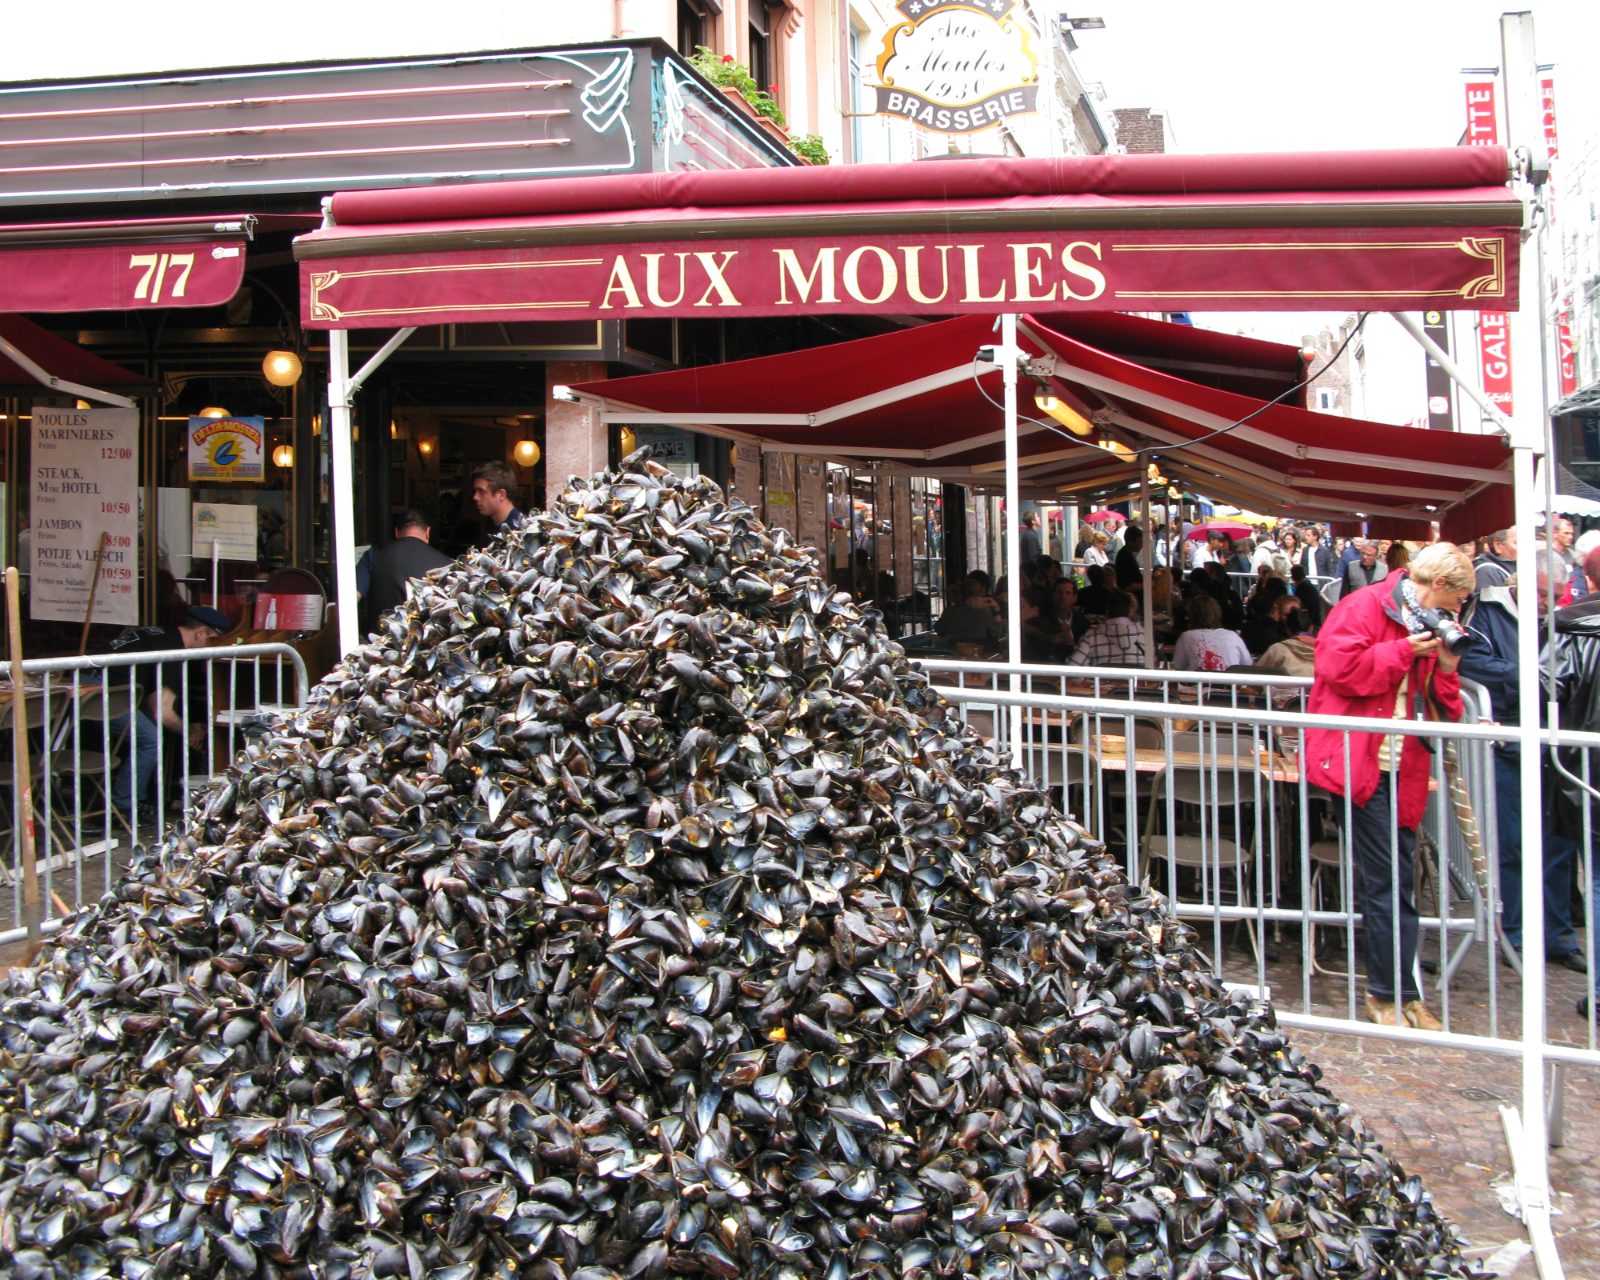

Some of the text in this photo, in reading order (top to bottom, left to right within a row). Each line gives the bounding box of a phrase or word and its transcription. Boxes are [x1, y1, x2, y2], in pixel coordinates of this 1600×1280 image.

[930, 16, 982, 41] Aux
[904, 49, 1006, 72] Moules
[925, 79, 985, 99] 1930
[887, 91, 1026, 130] BRASSERIE
[129, 252, 195, 303] 7/7
[598, 241, 1107, 309] AUX MOULES
[38, 414, 88, 426] MOULES
[38, 428, 114, 441] MARINIERES
[61, 482, 101, 495] HOTEL
[37, 518, 82, 530] JAMBON
[37, 547, 72, 560] POTJE
